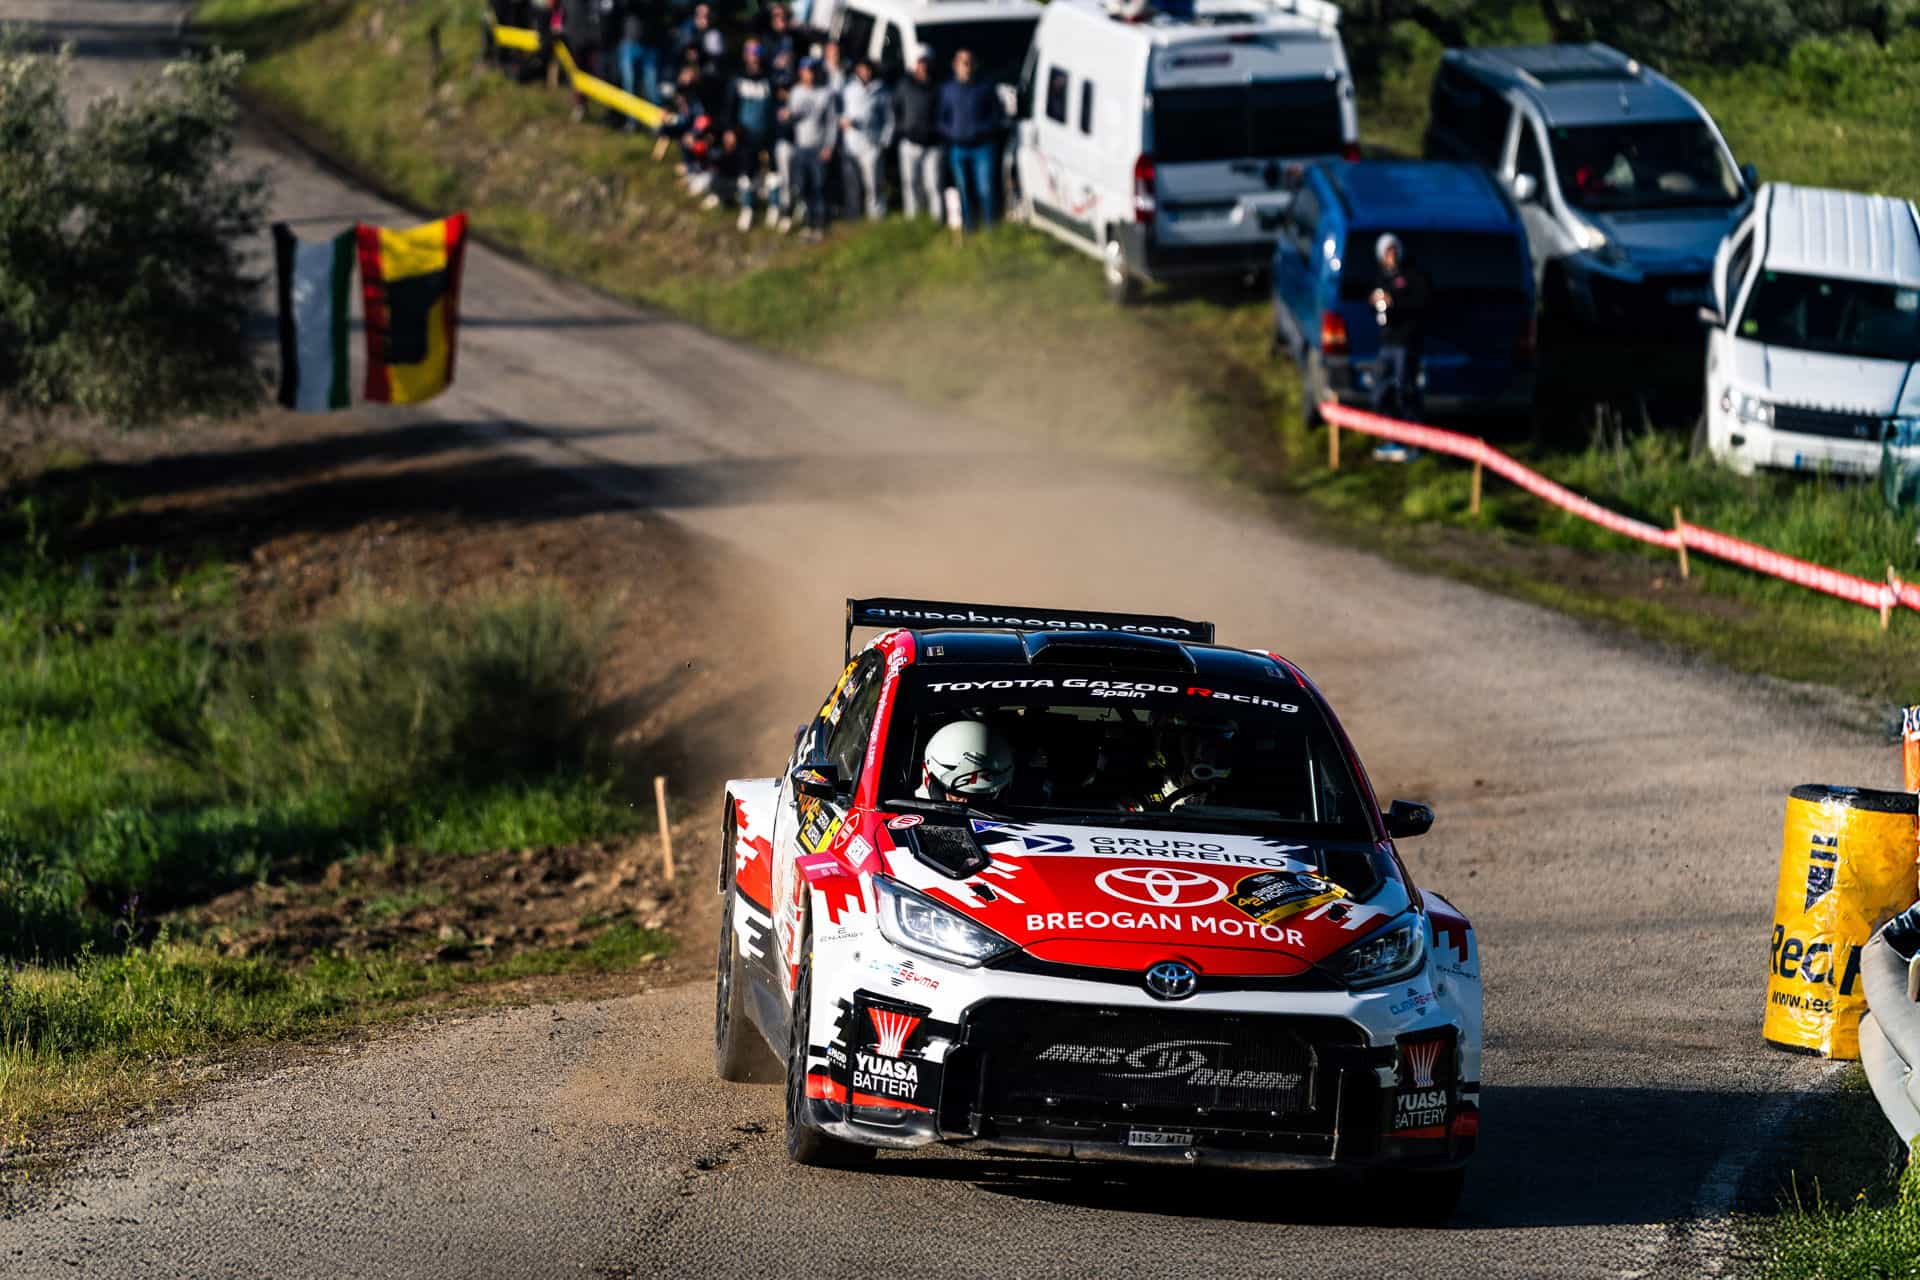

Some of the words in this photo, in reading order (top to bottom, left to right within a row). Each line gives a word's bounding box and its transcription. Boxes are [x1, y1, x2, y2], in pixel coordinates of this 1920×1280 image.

[927, 679, 1054, 693] TOYOTA
[1062, 678, 1179, 694] GAZOO
[1186, 687, 1300, 713] Racing
[1090, 687, 1147, 699] Spain
[1089, 836, 1225, 852] GRUPO
[1093, 846, 1286, 867] BARREIRO
[1026, 911, 1182, 931] BREOGAN
[1191, 915, 1306, 947] MOTOR
[855, 1051, 918, 1083] YUASA
[853, 1071, 918, 1099] BATTERY
[1396, 1089, 1447, 1111] YUASA
[1395, 1107, 1447, 1129] BATTERY
